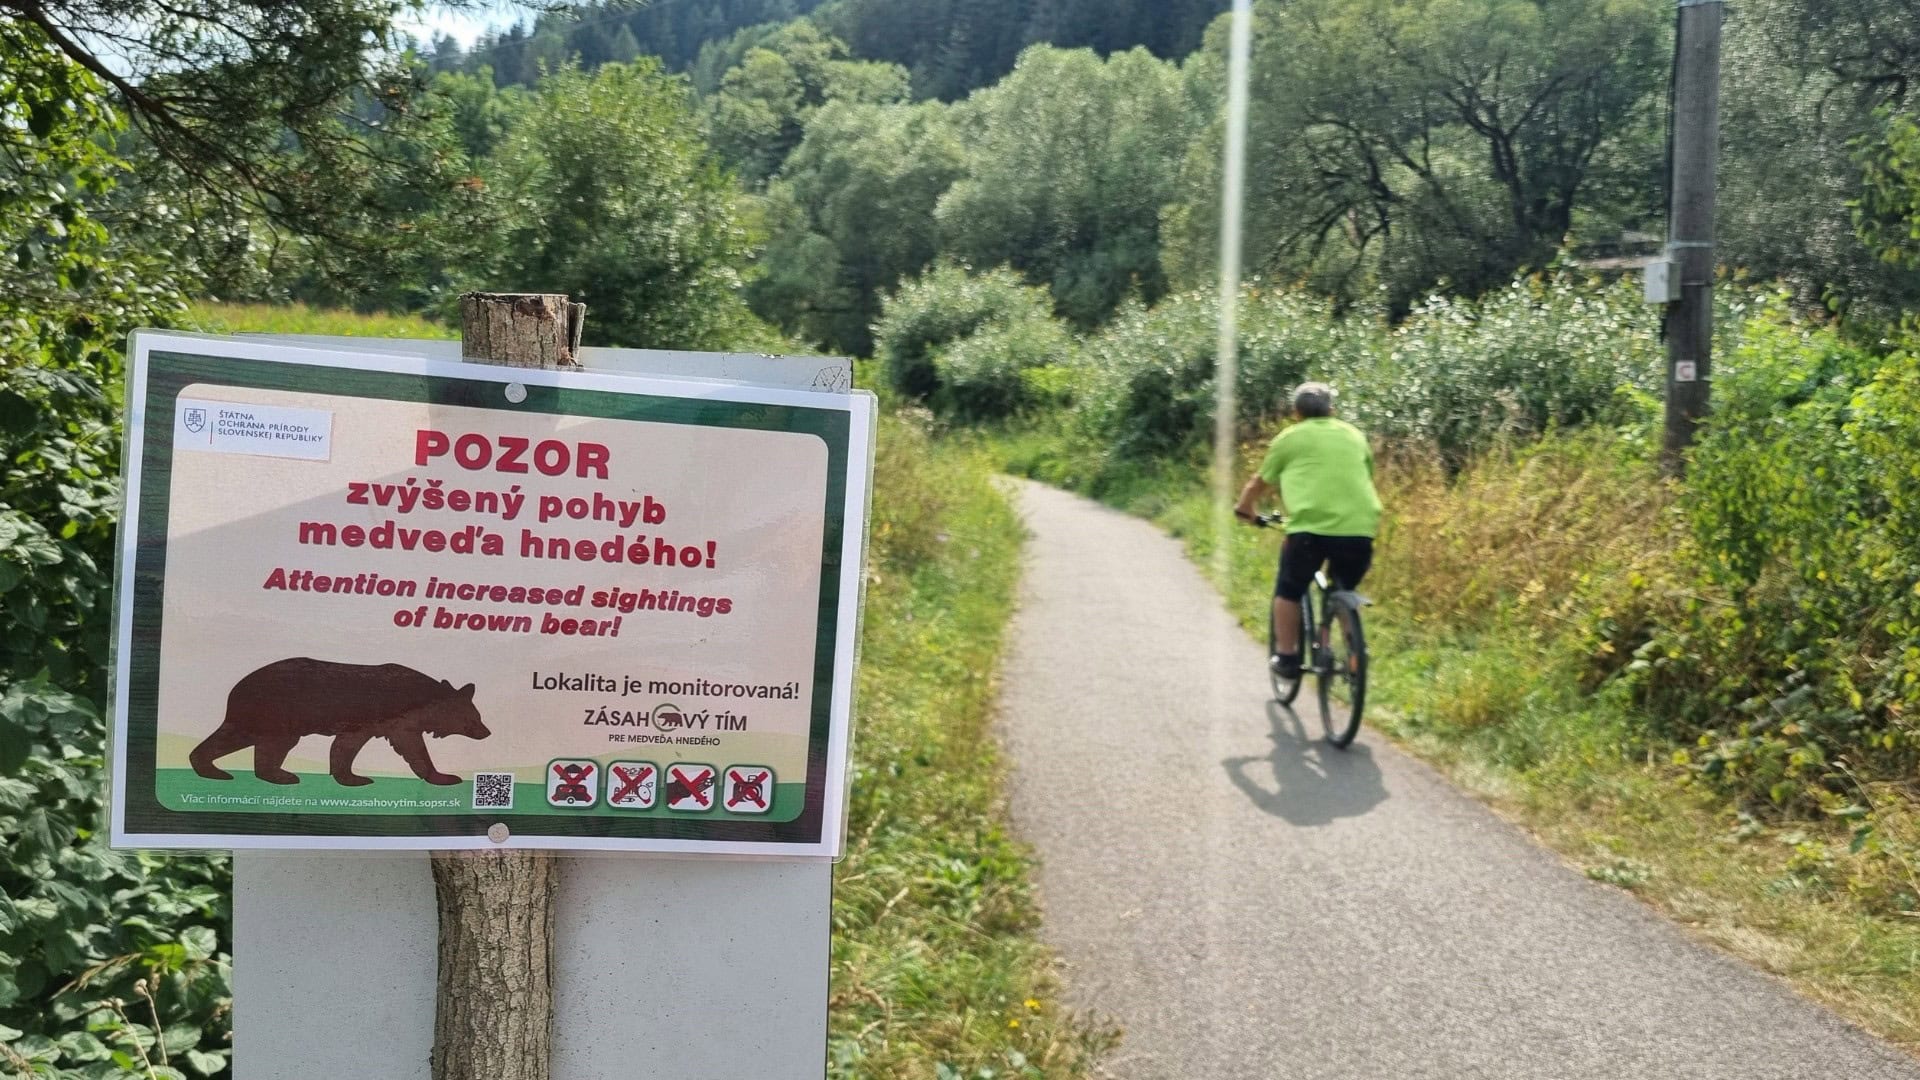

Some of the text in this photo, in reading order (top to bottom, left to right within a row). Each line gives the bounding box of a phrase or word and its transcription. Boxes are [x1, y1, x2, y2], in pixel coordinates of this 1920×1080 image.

[218, 419, 309, 433] OCHRANA PRÍRODY
[219, 409, 255, 420] ŠTÁTNA
[218, 428, 323, 442] SLOVENSKEJ REPUBLIKY
[415, 429, 610, 480] POZOR
[346, 477, 667, 528] zvýšený pohyb
[298, 520, 717, 569] medveďa hnedého!
[262, 567, 733, 617] Attention increased sightings
[393, 606, 623, 638] of brown bear!
[532, 671, 800, 700] Lokalita je monitorovaná!
[715, 710, 747, 731] TÍM
[608, 733, 721, 746] PRE MEDVEĎA HNEDÉHO
[262, 795, 302, 807] nájdete
[304, 798, 318, 806] na
[319, 797, 461, 809] www.zasahovytim.sopsr.sk
